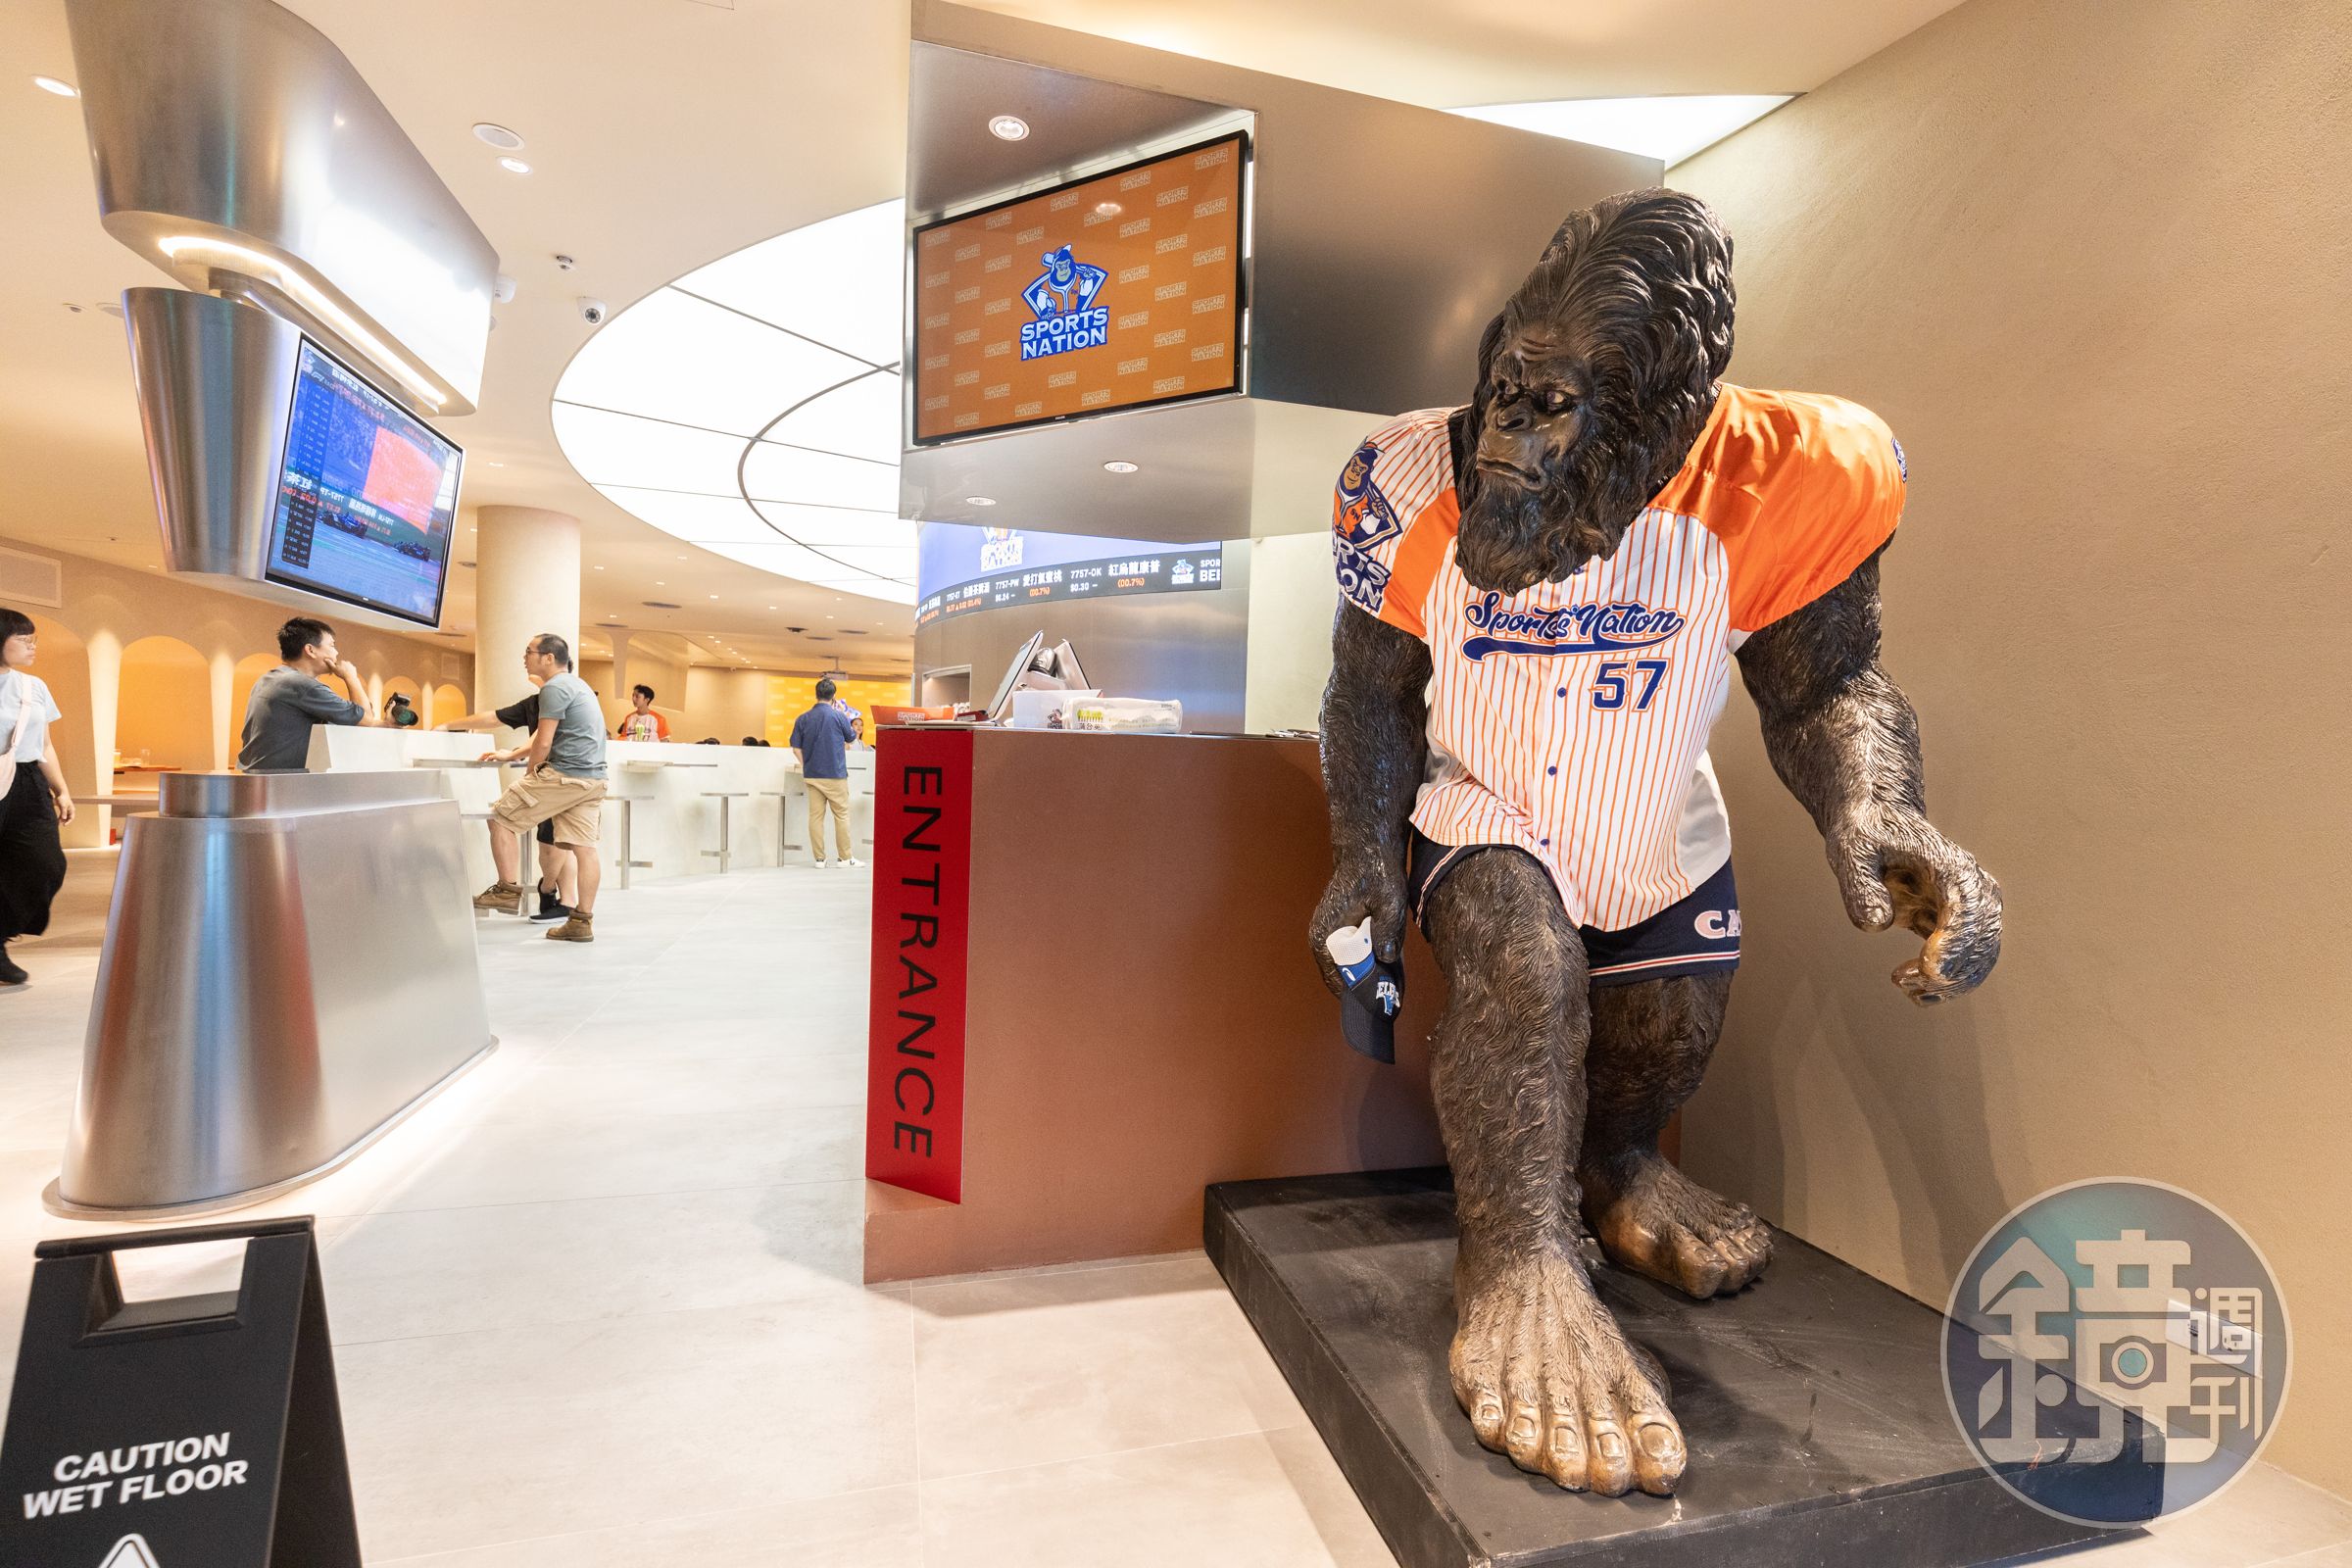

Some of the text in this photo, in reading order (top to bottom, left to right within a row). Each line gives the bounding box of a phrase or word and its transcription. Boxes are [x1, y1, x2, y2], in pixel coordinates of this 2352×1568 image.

[1196, 149, 1227, 164] SPORTS
[1196, 156, 1227, 169] NATION
[1121, 172, 1151, 185] SPORTS
[1122, 178, 1150, 190] NATION
[1157, 187, 1188, 201] SPORTS
[1157, 194, 1187, 206] NATION
[1195, 197, 1227, 212] SPORTS
[1196, 204, 1226, 218] NATION
[1120, 219, 1150, 232] SPORTS
[1121, 225, 1150, 237] NATION
[1156, 235, 1187, 248] SPORTS
[1157, 242, 1187, 253] NATION
[1194, 247, 1225, 261] SPORTS
[1194, 254, 1225, 266] NATION
[1119, 266, 1149, 278] SPORTS
[1120, 272, 1149, 283] NATION
[1155, 282, 1186, 295] SPORTS
[1156, 289, 1186, 300] NATION
[1193, 295, 1225, 308] SPORTS
[1193, 302, 1224, 314] NATION
[1119, 312, 1149, 323] SPORTS
[1119, 318, 1148, 329] NATION
[1021, 308, 1107, 341] SPORTS
[1154, 329, 1185, 341] SPORTS
[1022, 326, 1105, 359] NATION
[1155, 336, 1185, 347] NATION
[1192, 343, 1223, 355] SPORTS
[1193, 351, 1223, 361] NATION
[1118, 358, 1148, 369] SPORTS
[1118, 365, 1147, 374] NATION
[1154, 376, 1184, 388] SPORTS
[1154, 383, 1184, 393] NATION
[1070, 567, 1102, 578] 7757-OK
[1108, 560, 1160, 577] 紅烏龍康普
[1117, 577, 1146, 588] (00.7%)
[1575, 603, 1685, 645] Nation
[1593, 661, 1668, 710] 57
[893, 764, 943, 1158] ENTRANCE
[54, 1432, 231, 1483] CAUTION
[24, 1460, 249, 1520] WET FLOOR
